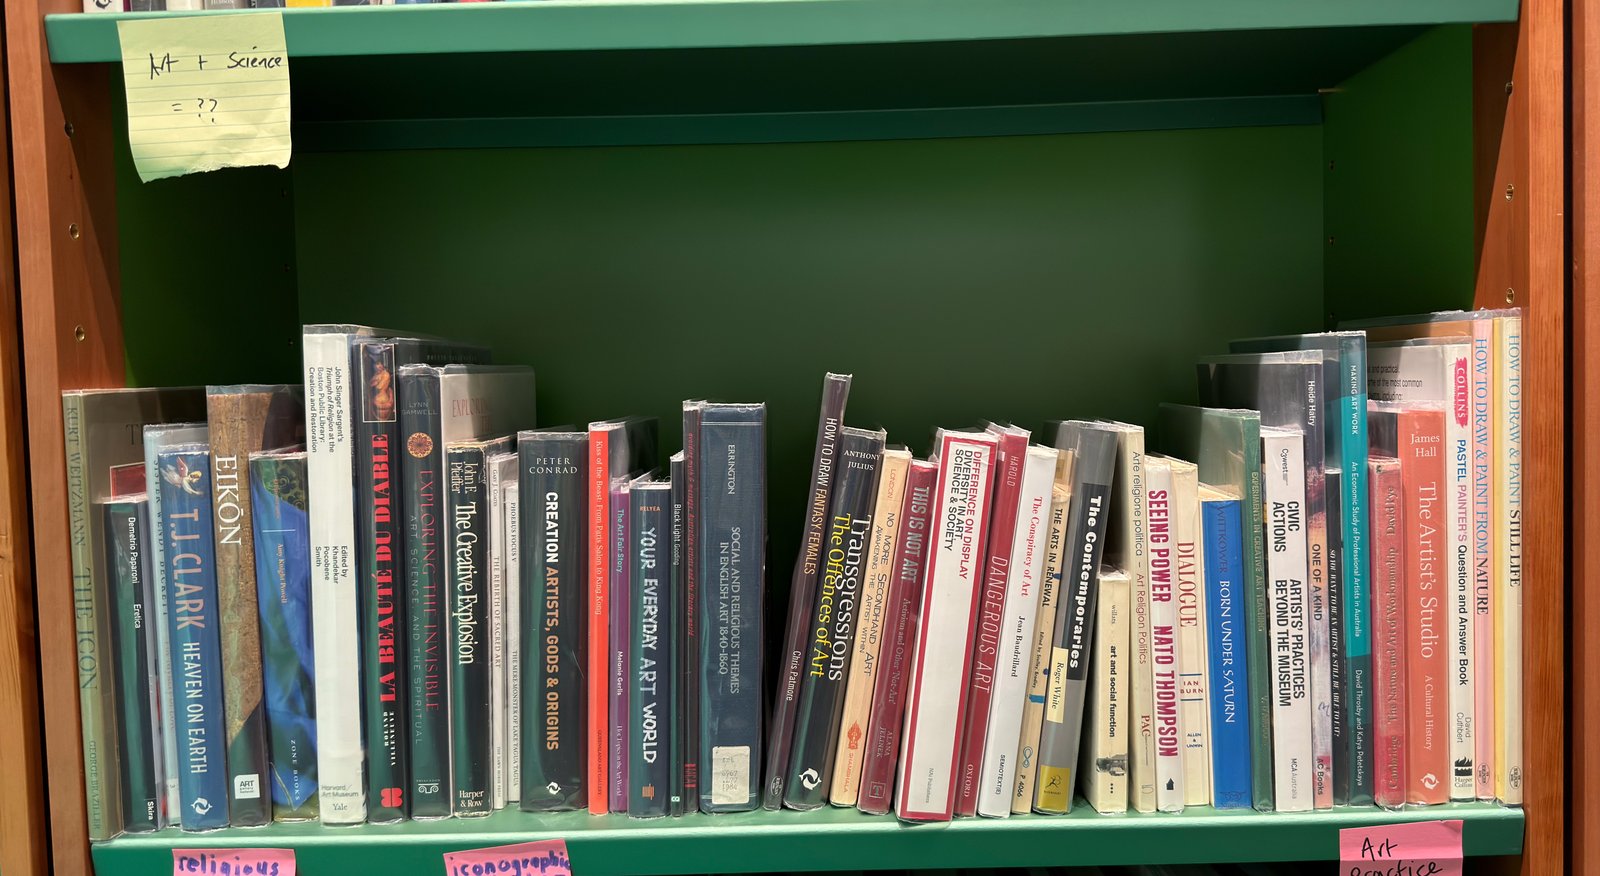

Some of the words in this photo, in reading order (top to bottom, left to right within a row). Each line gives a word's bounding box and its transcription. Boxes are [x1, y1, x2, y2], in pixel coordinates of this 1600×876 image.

[150, 53, 179, 80] Art
[227, 46, 283, 70] Science
[1475, 338, 1488, 374] HOW
[1508, 335, 1520, 372] HOW
[317, 366, 325, 391] Boston
[326, 366, 334, 395] Triumph
[335, 366, 343, 383] John
[1456, 367, 1466, 419] COLLINS
[1475, 377, 1488, 399] TO
[1508, 374, 1520, 396] TO
[335, 384, 344, 408] Singer
[310, 413, 318, 453] Restoration
[318, 416, 327, 443] Library:
[327, 404, 335, 432] Religion
[335, 410, 345, 443] Sargent's
[824, 417, 838, 441] HOW
[1475, 402, 1488, 447] DRAW
[1508, 400, 1520, 444] DRAW
[821, 443, 833, 455] TO
[1410, 434, 1440, 445] James
[1415, 447, 1437, 457] Hall
[1475, 449, 1487, 460] &
[1509, 447, 1520, 459] &
[372, 434, 391, 522] DIABLE
[529, 467, 578, 475] CONRAD
[536, 457, 571, 465] PETER
[596, 457, 603, 465] of
[817, 458, 831, 487] DRAW
[1457, 439, 1467, 482] PASTEL
[911, 486, 930, 514] THIS
[967, 451, 983, 516] DIFFERENCE
[1419, 482, 1437, 519] The
[1475, 464, 1488, 508] PAINT
[1509, 463, 1520, 507] PAINT
[420, 469, 437, 576] EXPLORING
[455, 502, 477, 530] The
[545, 491, 559, 563] CREATION
[674, 504, 682, 523] Black
[811, 487, 826, 530] FANTASY
[908, 516, 924, 530] IS
[964, 518, 975, 534] ON
[1087, 496, 1102, 527] The
[1148, 490, 1170, 543] SEEING
[1272, 501, 1286, 553] ACTIONS
[1287, 501, 1300, 532] CIVIC
[1457, 484, 1468, 542] PAINTER'S
[128, 517, 138, 551] Demetrio
[170, 508, 200, 548] T.J.
[673, 524, 682, 542] Light
[731, 526, 741, 565] SOCIAL
[831, 512, 851, 545] The
[904, 531, 922, 557] NOT
[1476, 511, 1488, 554] FROM
[1509, 509, 1521, 552] STILL
[375, 532, 392, 562] DU
[456, 532, 478, 592] Creative
[639, 527, 657, 570] YOUR
[672, 543, 681, 566] Gooding
[804, 531, 821, 575] FEMALES
[960, 535, 973, 579] DISPLAY
[1419, 524, 1437, 590] Artist's
[130, 552, 141, 584] Paparoni
[594, 576, 603, 594] King
[730, 567, 740, 593] AND
[818, 547, 845, 623] Offences
[901, 558, 918, 583] ART
[1150, 548, 1172, 602] POWER
[1177, 542, 1198, 628] DIALOGUE
[1456, 544, 1468, 592] Question
[1476, 557, 1489, 615] NATURE
[1509, 554, 1521, 587] LIFE
[74, 567, 94, 620] THE
[172, 553, 206, 631] CLARK
[422, 582, 436, 613] THE
[493, 574, 501, 607] REBIRTH
[544, 566, 559, 631] ARTISTS,
[594, 595, 603, 615] Kong
[828, 514, 872, 681] Transgressions
[979, 556, 1008, 655] DANGEROUS
[1070, 531, 1097, 669] Contemporaries
[1219, 580, 1231, 617] BORN
[1275, 579, 1289, 626] BEYOND
[1289, 579, 1303, 631] ARTISTS'
[1458, 594, 1468, 614] and
[134, 604, 143, 629] Eretica
[372, 569, 395, 664] BEAUTÉ
[453, 593, 479, 666] Explosion
[494, 609, 501, 620] OF
[641, 578, 659, 651] EVERYDAY
[730, 595, 741, 649] RELIGIOUS
[1420, 596, 1439, 658] Studio
[546, 635, 559, 674] GODS
[815, 626, 832, 649] of
[1153, 625, 1174, 665] NATO
[1221, 619, 1233, 666] UNDER
[1277, 628, 1290, 652] THE
[1458, 616, 1468, 656] Answer
[76, 628, 97, 691] ICON
[182, 642, 203, 700] HEAVEN
[423, 624, 439, 713] INVISIBLE
[639, 656, 657, 696] ART
[730, 651, 740, 694] THEMES
[810, 648, 829, 678] Art
[973, 660, 992, 694] ART
[1052, 661, 1064, 684] Roger
[1291, 634, 1305, 699] PRACTICES
[1459, 658, 1469, 686] Book
[379, 671, 396, 704] LA
[546, 678, 558, 688] &
[1050, 685, 1062, 710] White
[1222, 669, 1236, 723] SATURN
[1278, 655, 1291, 707] MUSEUM
[187, 704, 204, 724] ON
[546, 692, 559, 750] ORIGINS
[1109, 703, 1117, 738] function
[1155, 670, 1178, 757] THOMPSON
[1354, 690, 1363, 716] Throsby
[642, 702, 659, 763] WORLD
[1355, 717, 1363, 730] and
[1355, 731, 1364, 750] Katya
[187, 728, 208, 774] EARTH
[1356, 751, 1365, 786] Petetskaya
[995, 754, 1006, 795] SEMIOTEXT(E)
[1361, 837, 1398, 862] Art
